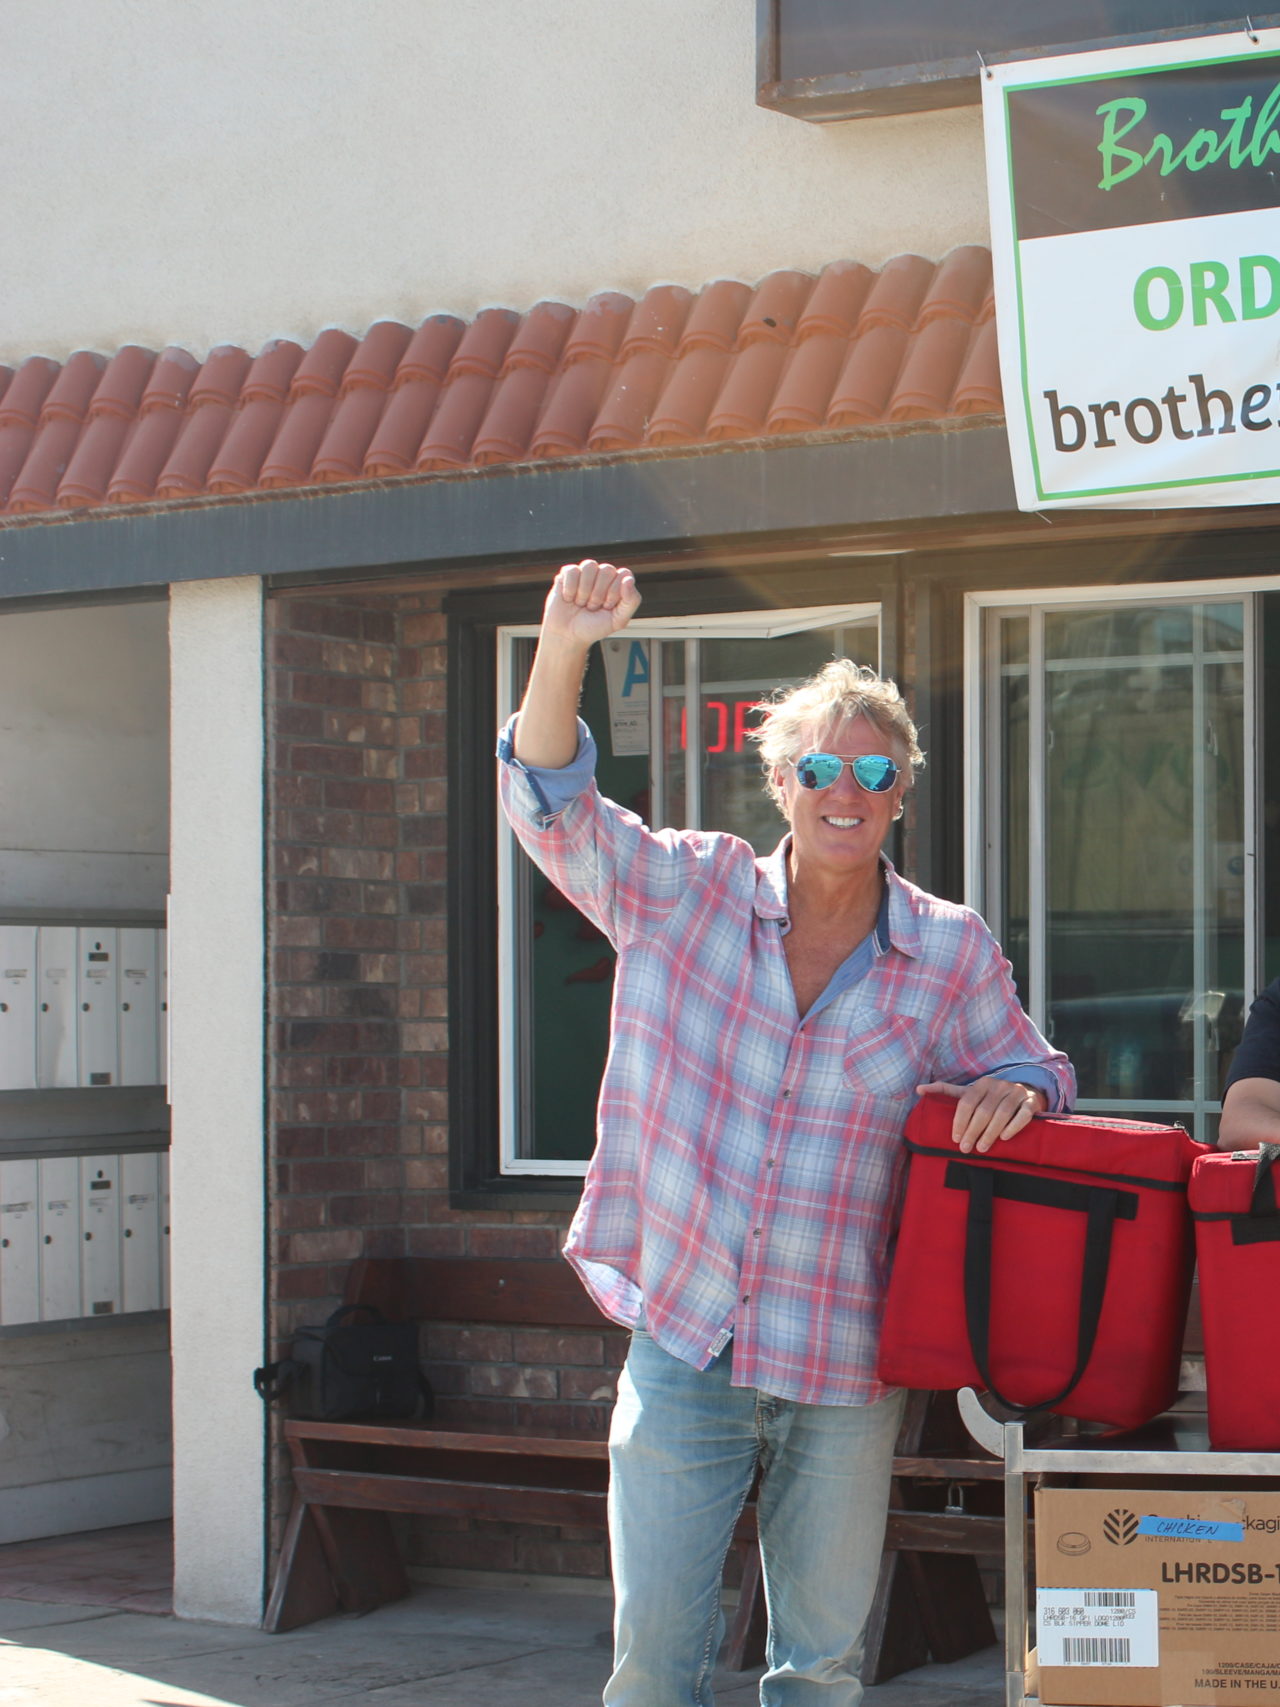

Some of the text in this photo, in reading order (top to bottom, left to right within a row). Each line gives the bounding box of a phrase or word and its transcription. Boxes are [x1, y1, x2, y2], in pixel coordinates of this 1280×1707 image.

[1156, 1520, 1220, 1536] CHICKEN
[1195, 1679, 1227, 1688] MADE
[1230, 1679, 1241, 1688] IN
[1244, 1679, 1267, 1689] THE
